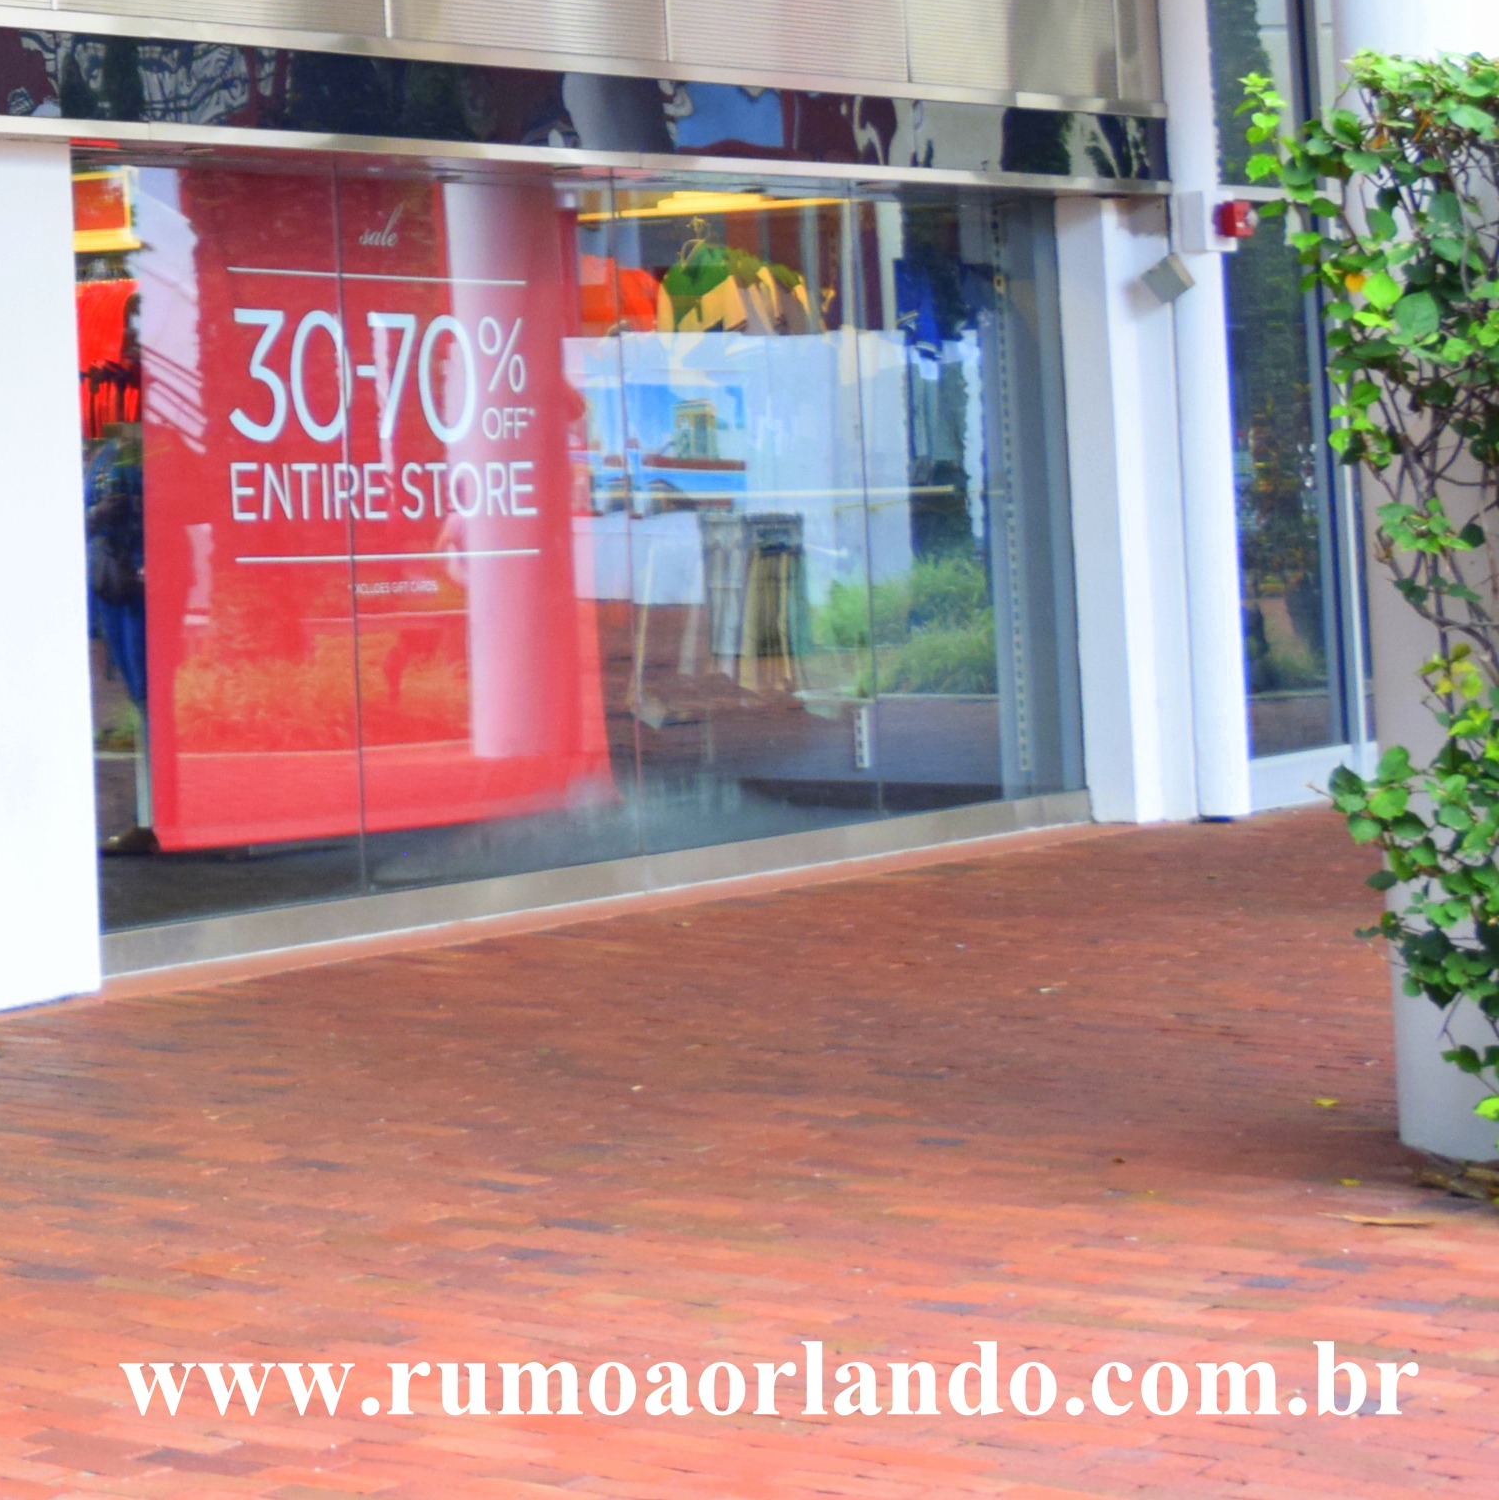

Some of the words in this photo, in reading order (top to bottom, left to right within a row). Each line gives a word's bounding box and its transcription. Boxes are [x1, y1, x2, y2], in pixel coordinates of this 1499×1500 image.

[358, 202, 404, 247] sale
[229, 461, 389, 521] ENTIRE
[401, 461, 539, 520] STORE
